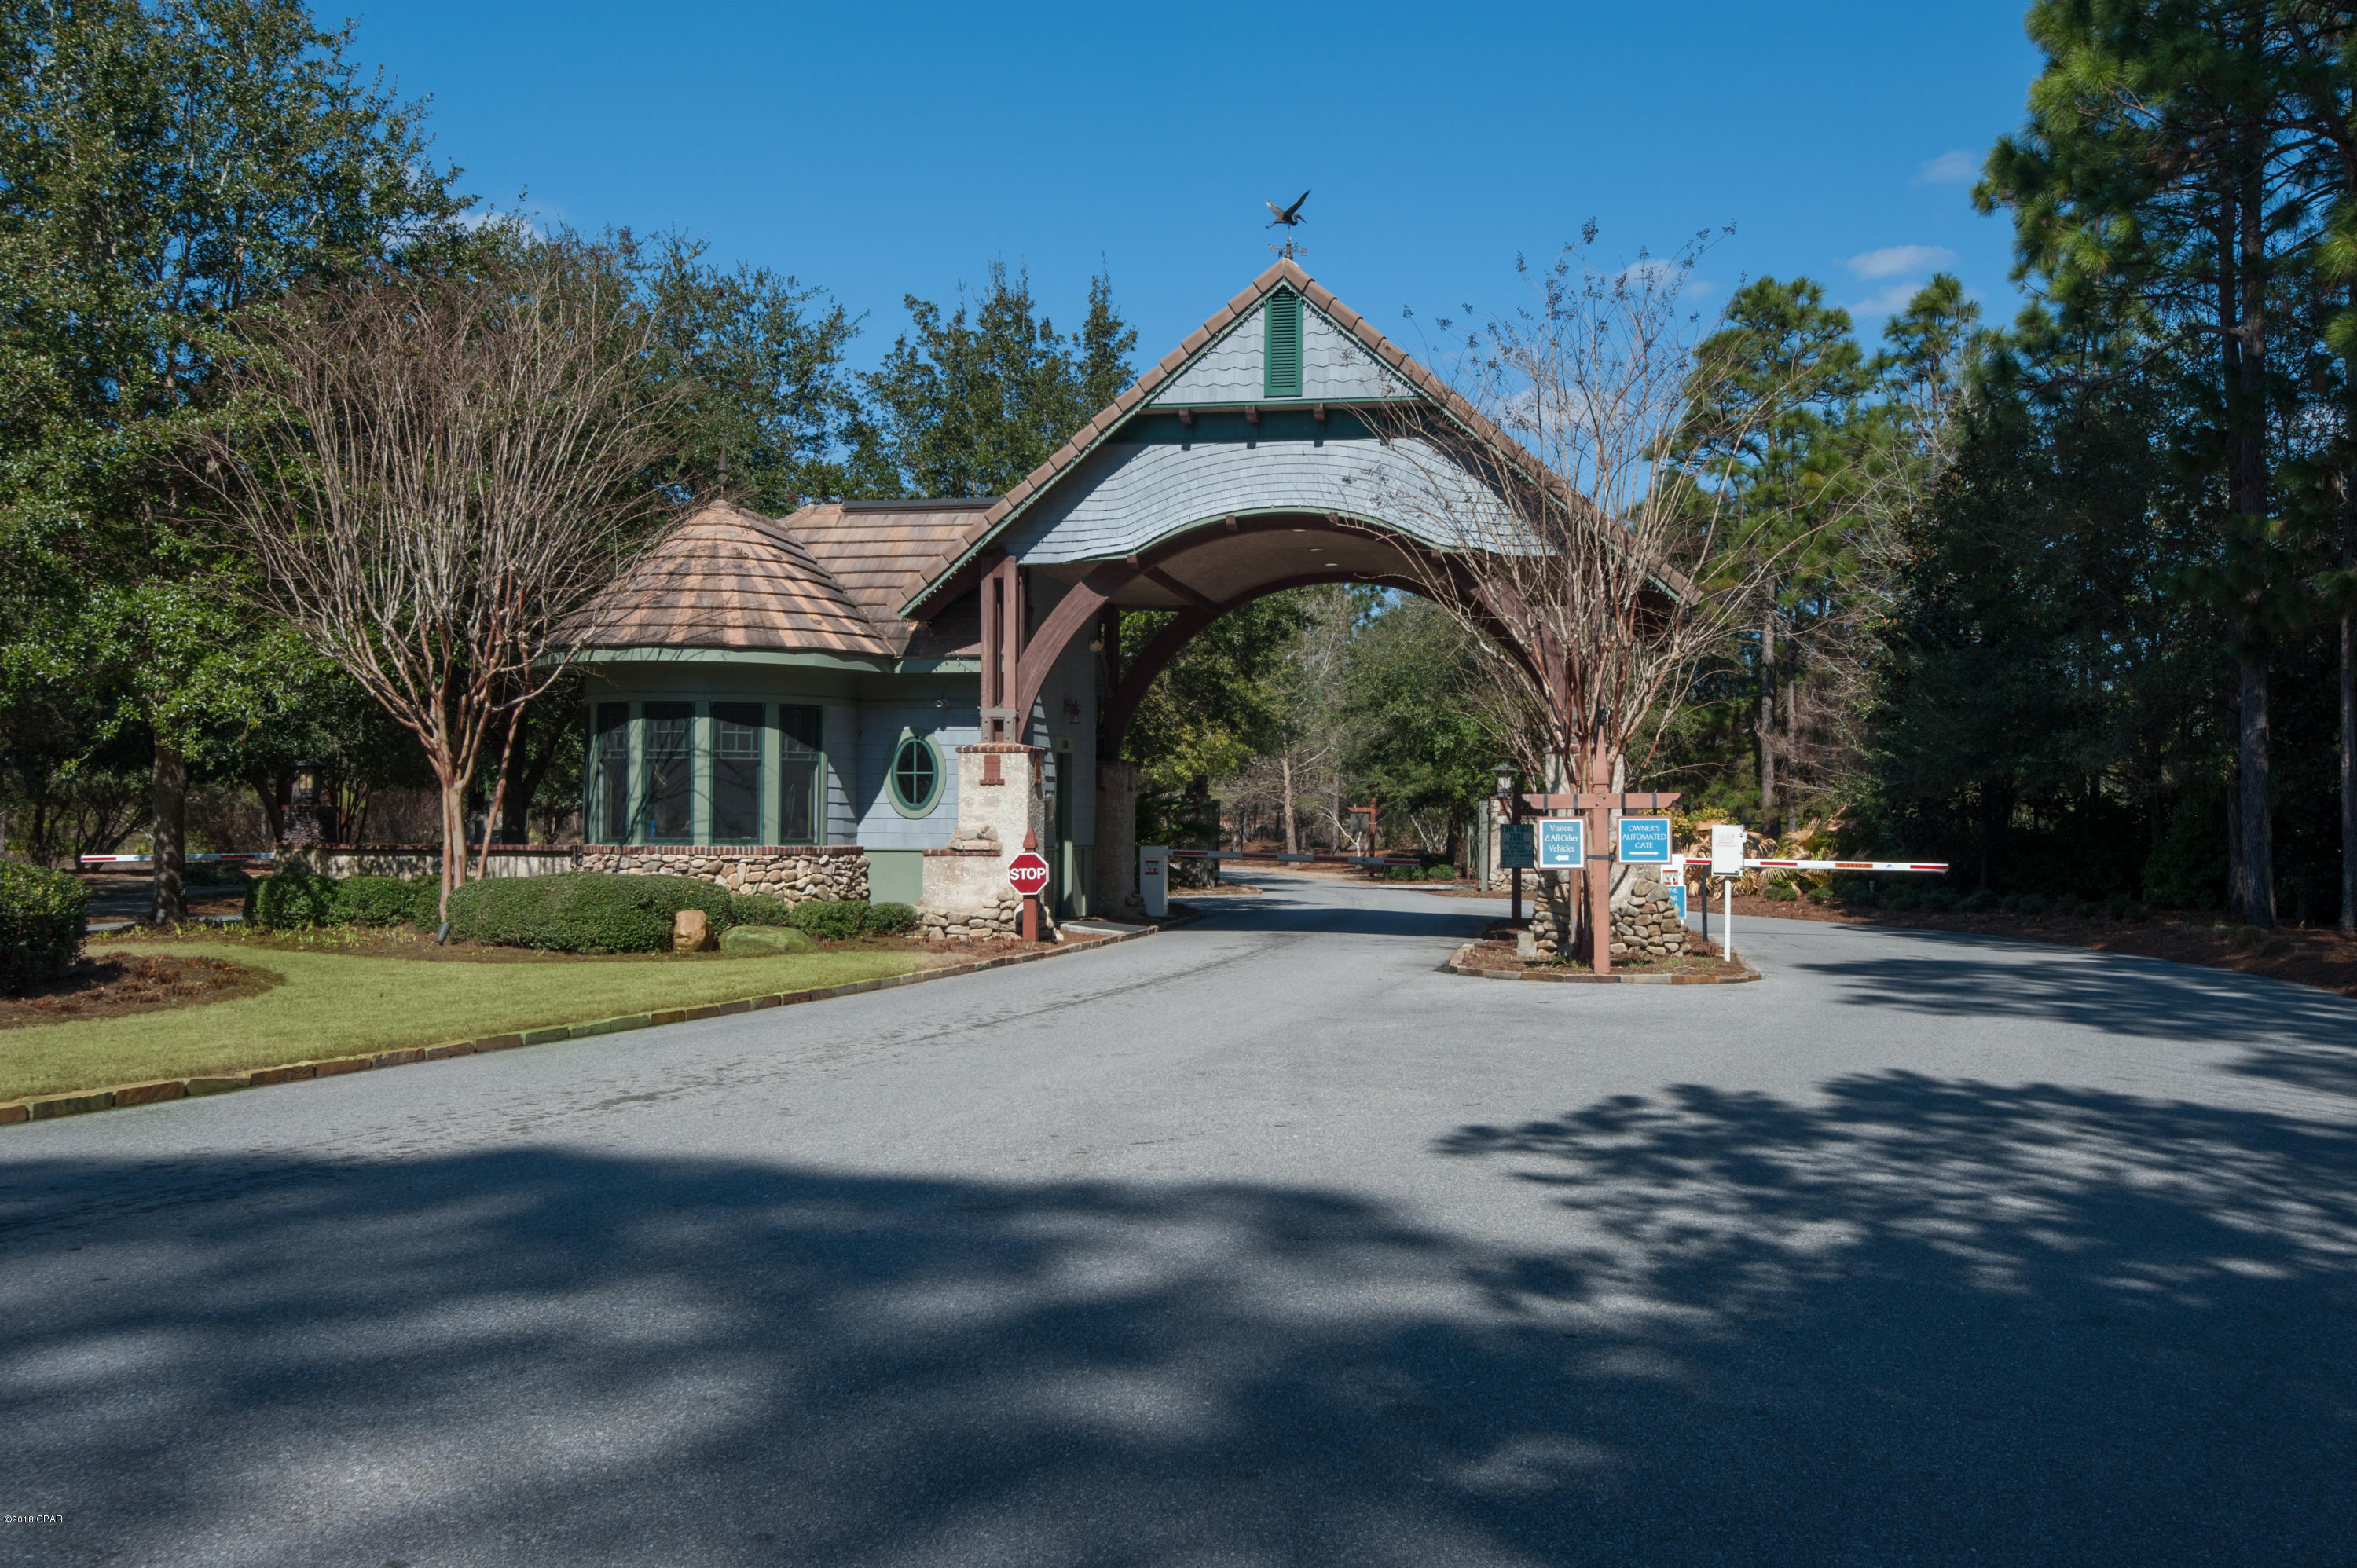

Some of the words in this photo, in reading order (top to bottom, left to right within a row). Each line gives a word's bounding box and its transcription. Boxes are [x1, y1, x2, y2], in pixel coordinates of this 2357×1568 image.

[1551, 833, 1560, 842] All
[1560, 833, 1578, 842] Other
[1549, 844, 1575, 852] Vehicles
[1010, 867, 1046, 881] STOP
